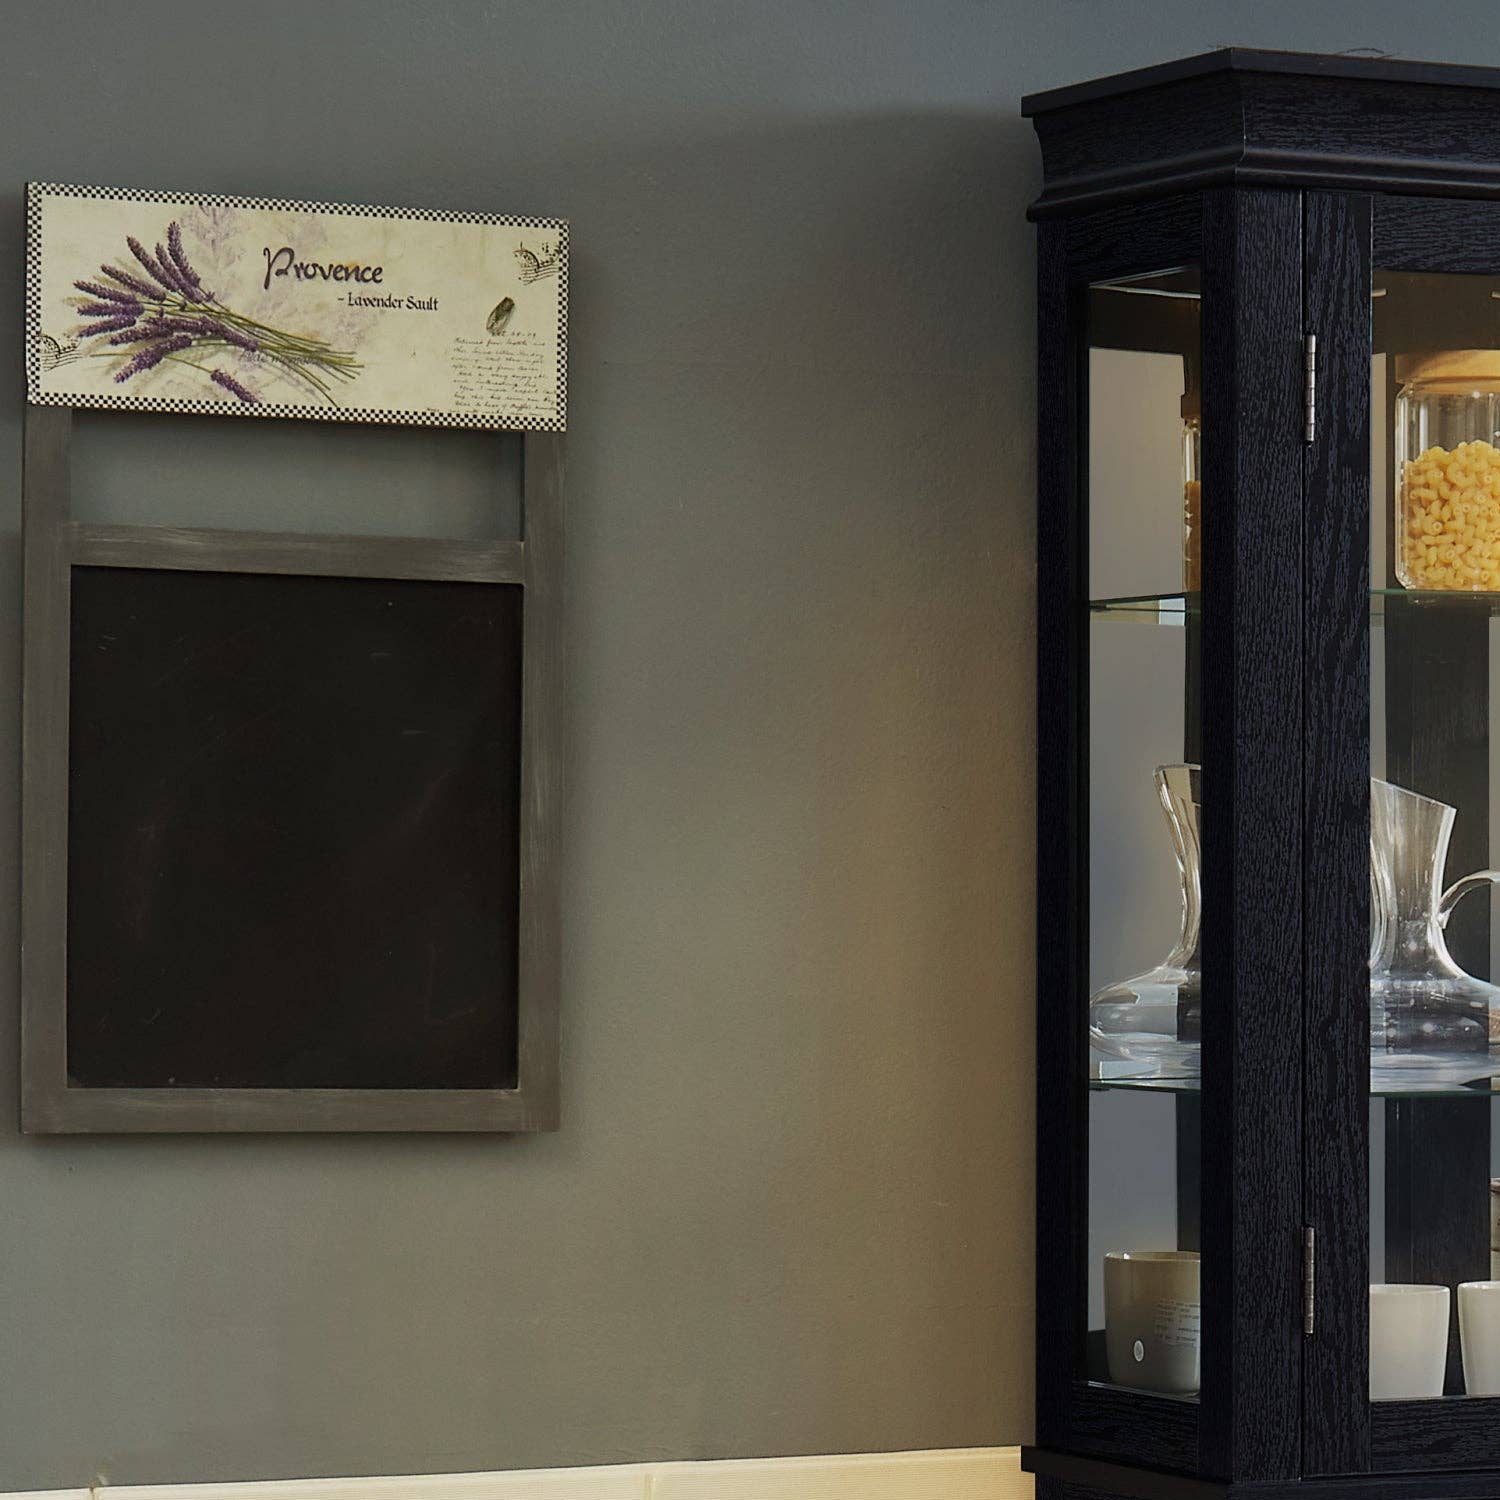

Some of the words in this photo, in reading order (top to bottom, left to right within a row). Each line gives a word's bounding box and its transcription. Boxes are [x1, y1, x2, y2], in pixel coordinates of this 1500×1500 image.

[263, 246, 384, 291] Provence
[347, 291, 404, 310] Lavender
[405, 295, 440, 311] Sault
